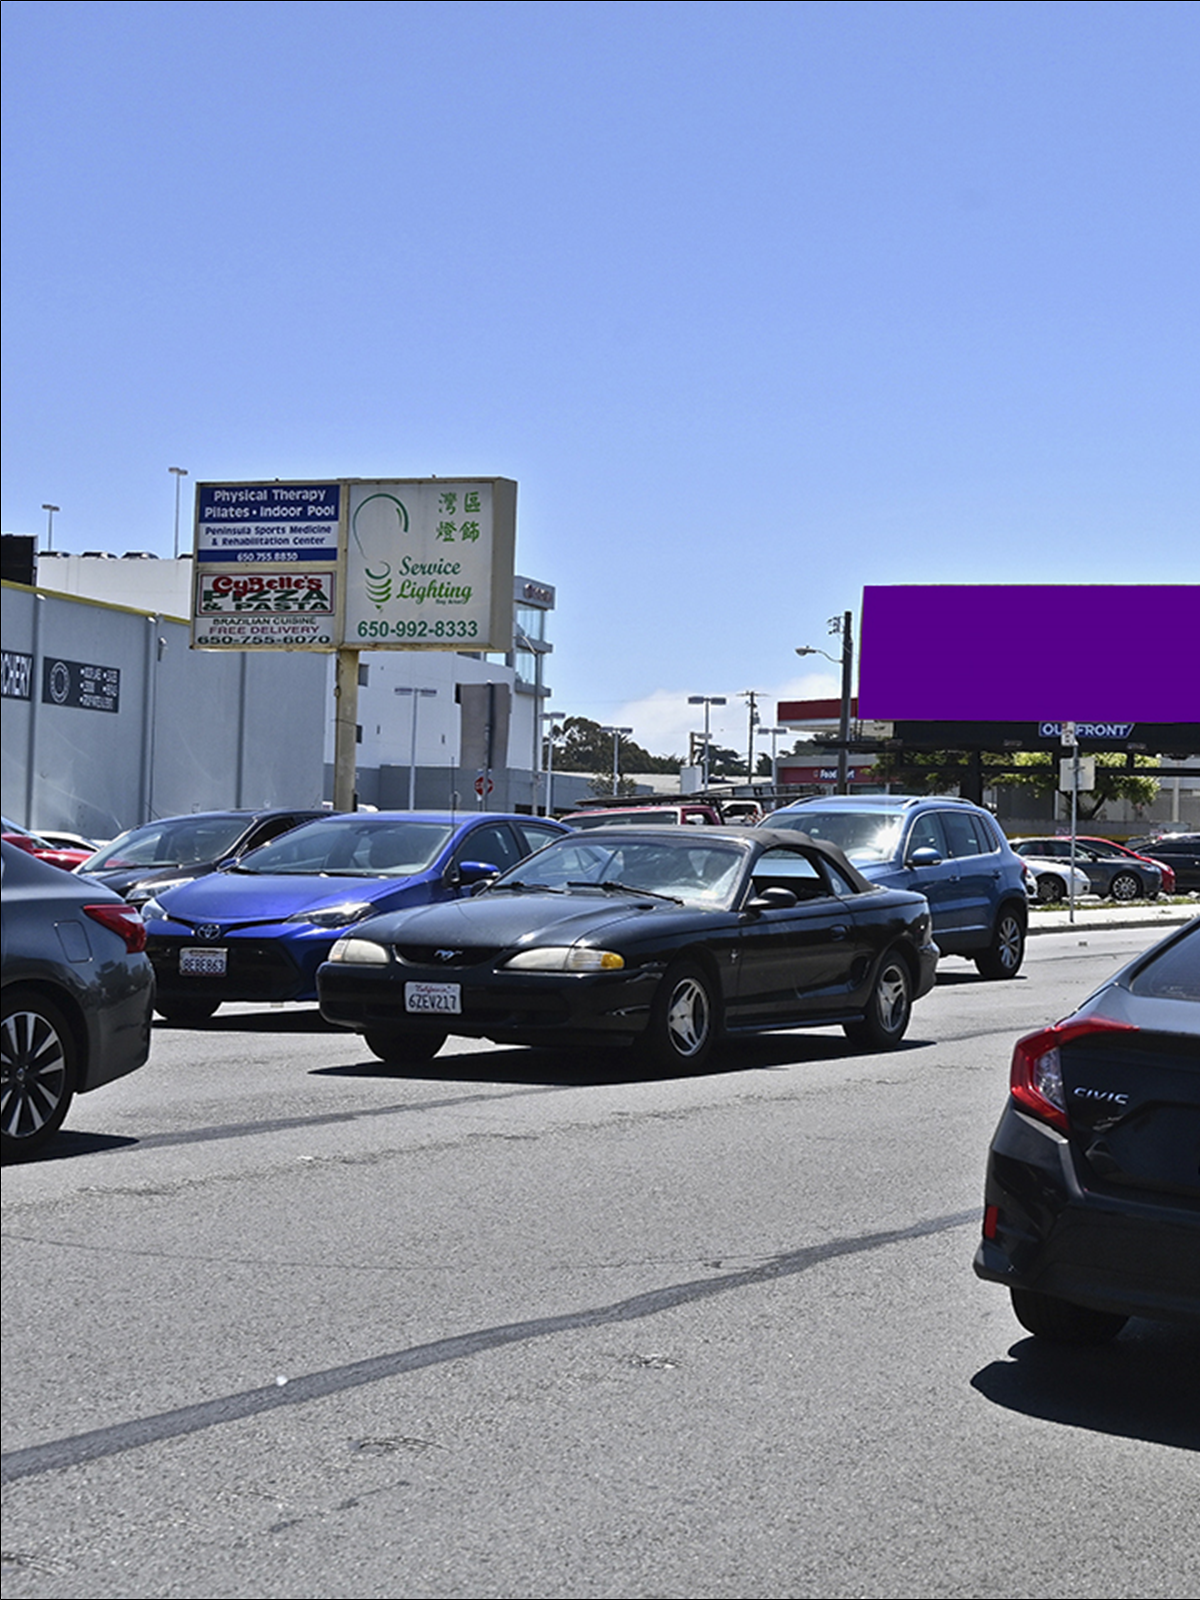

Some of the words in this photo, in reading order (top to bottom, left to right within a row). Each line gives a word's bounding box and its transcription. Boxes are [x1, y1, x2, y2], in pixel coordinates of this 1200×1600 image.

[214, 490, 268, 502] Physical
[272, 489, 326, 501] Therapy
[205, 506, 250, 518] Pilates
[260, 506, 303, 517] Indoor
[307, 505, 335, 516] Pool
[205, 526, 251, 536] Peninsula
[255, 526, 286, 536] Sports
[289, 525, 332, 535] Medicine
[222, 537, 290, 546] Rehabilitation
[292, 537, 325, 545] Center
[399, 555, 461, 576] Service
[203, 589, 329, 602] PIZZA
[396, 579, 473, 605] Lighting
[202, 602, 223, 611] &
[235, 601, 329, 611] PASTA
[213, 618, 270, 626] BRAZILIAN
[273, 617, 316, 625] CUISINE
[209, 626, 246, 635] FREE
[250, 625, 320, 634] DELIVERY
[358, 620, 478, 638] 650-992-8333
[1042, 722, 1128, 738] OUFRONT
[408, 993, 457, 1010] 6ZEV217
[1073, 1087, 1129, 1104] CIVIC
